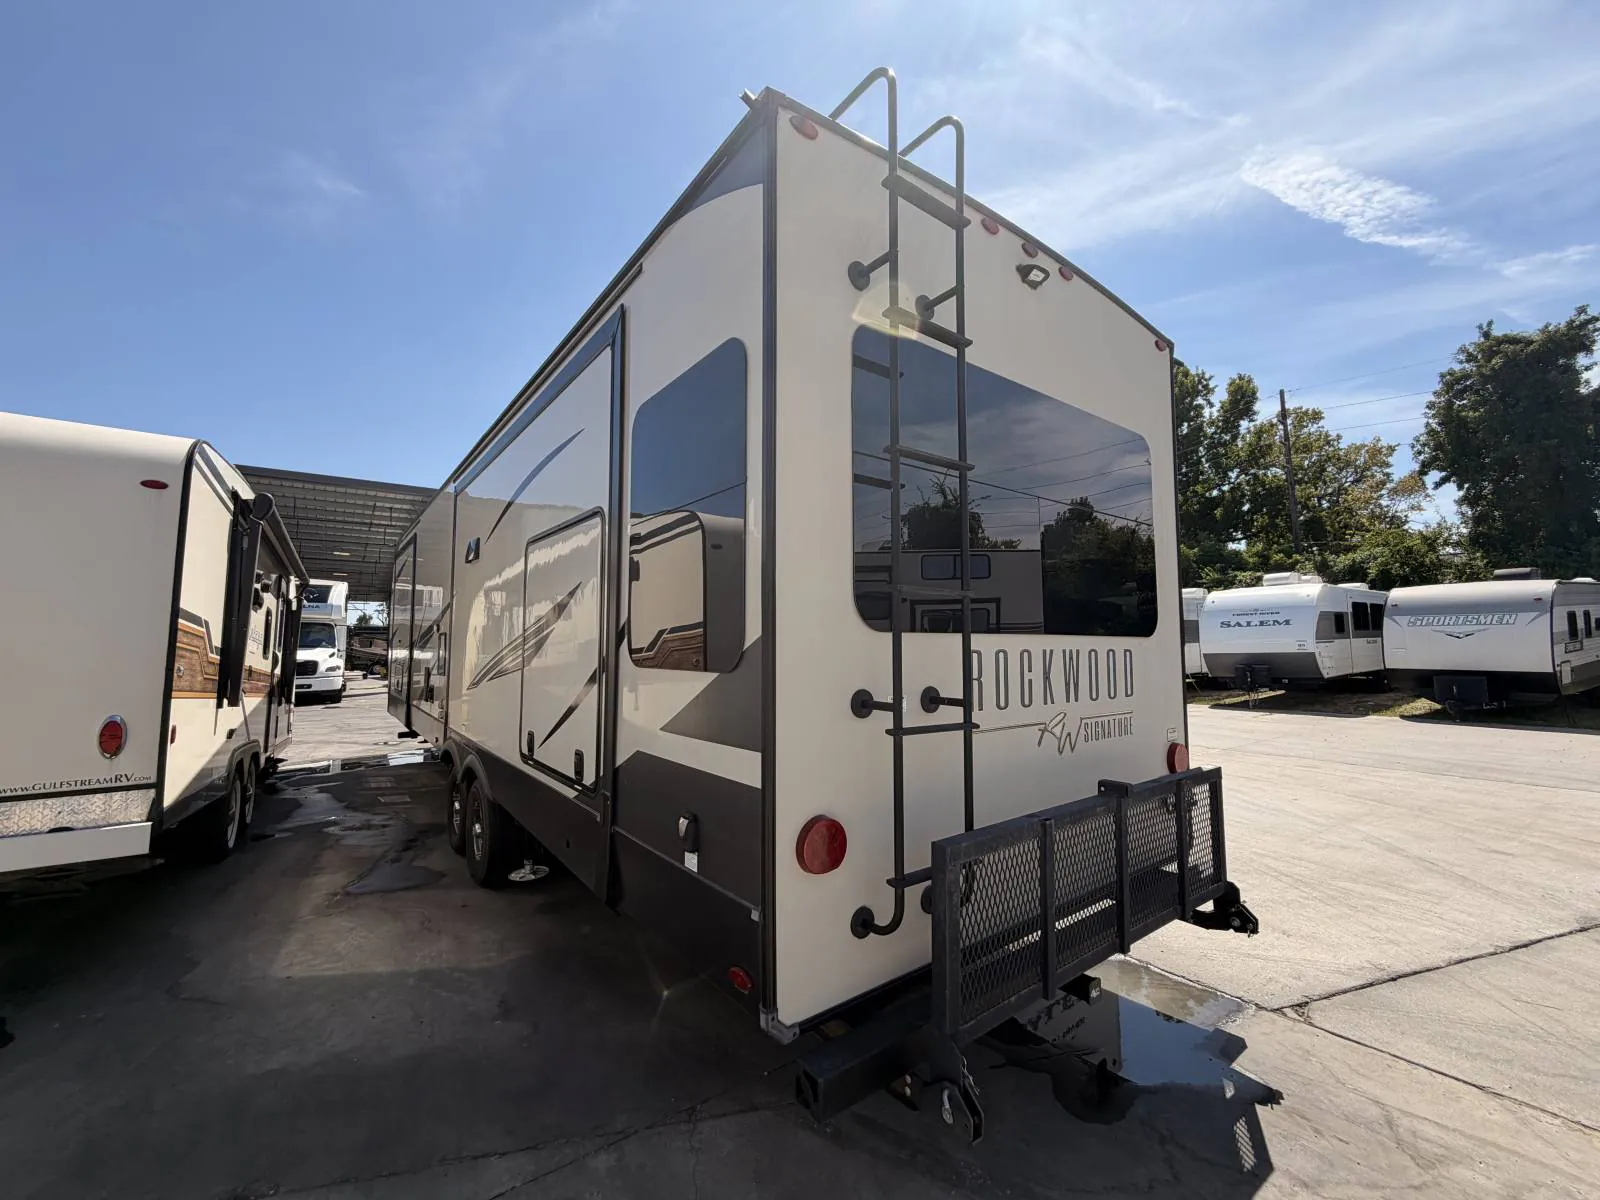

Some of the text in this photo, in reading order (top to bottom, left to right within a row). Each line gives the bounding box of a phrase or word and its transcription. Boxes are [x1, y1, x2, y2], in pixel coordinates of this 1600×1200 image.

[1219, 618, 1293, 629] SALEM
[1407, 613, 1518, 627] SPORTSMEN
[971, 648, 1134, 712] ROCKWOOD
[1083, 715, 1133, 743] SIGNATURE
